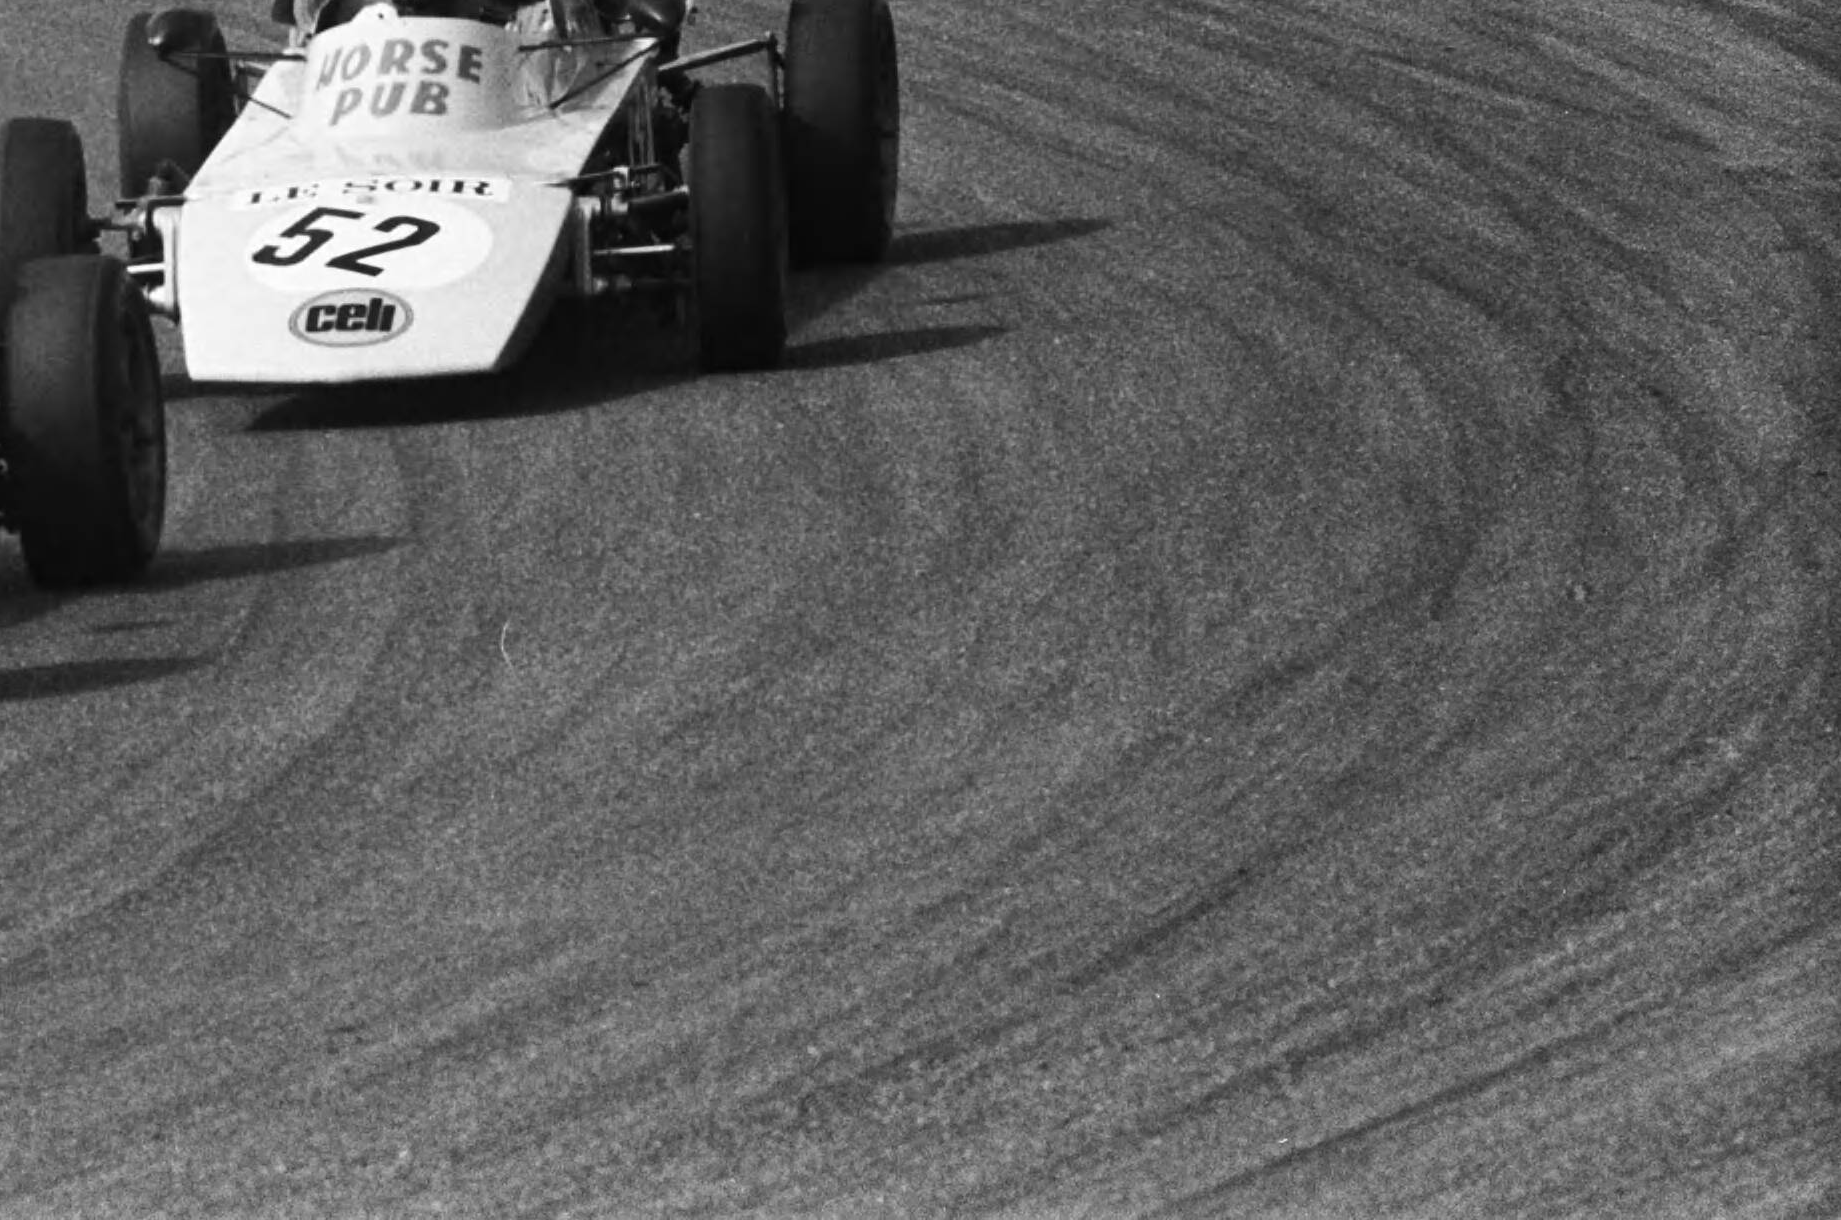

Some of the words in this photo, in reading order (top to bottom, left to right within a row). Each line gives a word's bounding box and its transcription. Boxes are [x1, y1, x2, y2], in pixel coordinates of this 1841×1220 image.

[328, 80, 450, 127] PUB
[250, 183, 321, 204] LE
[341, 179, 495, 197] SOIR
[251, 206, 441, 278] 52
